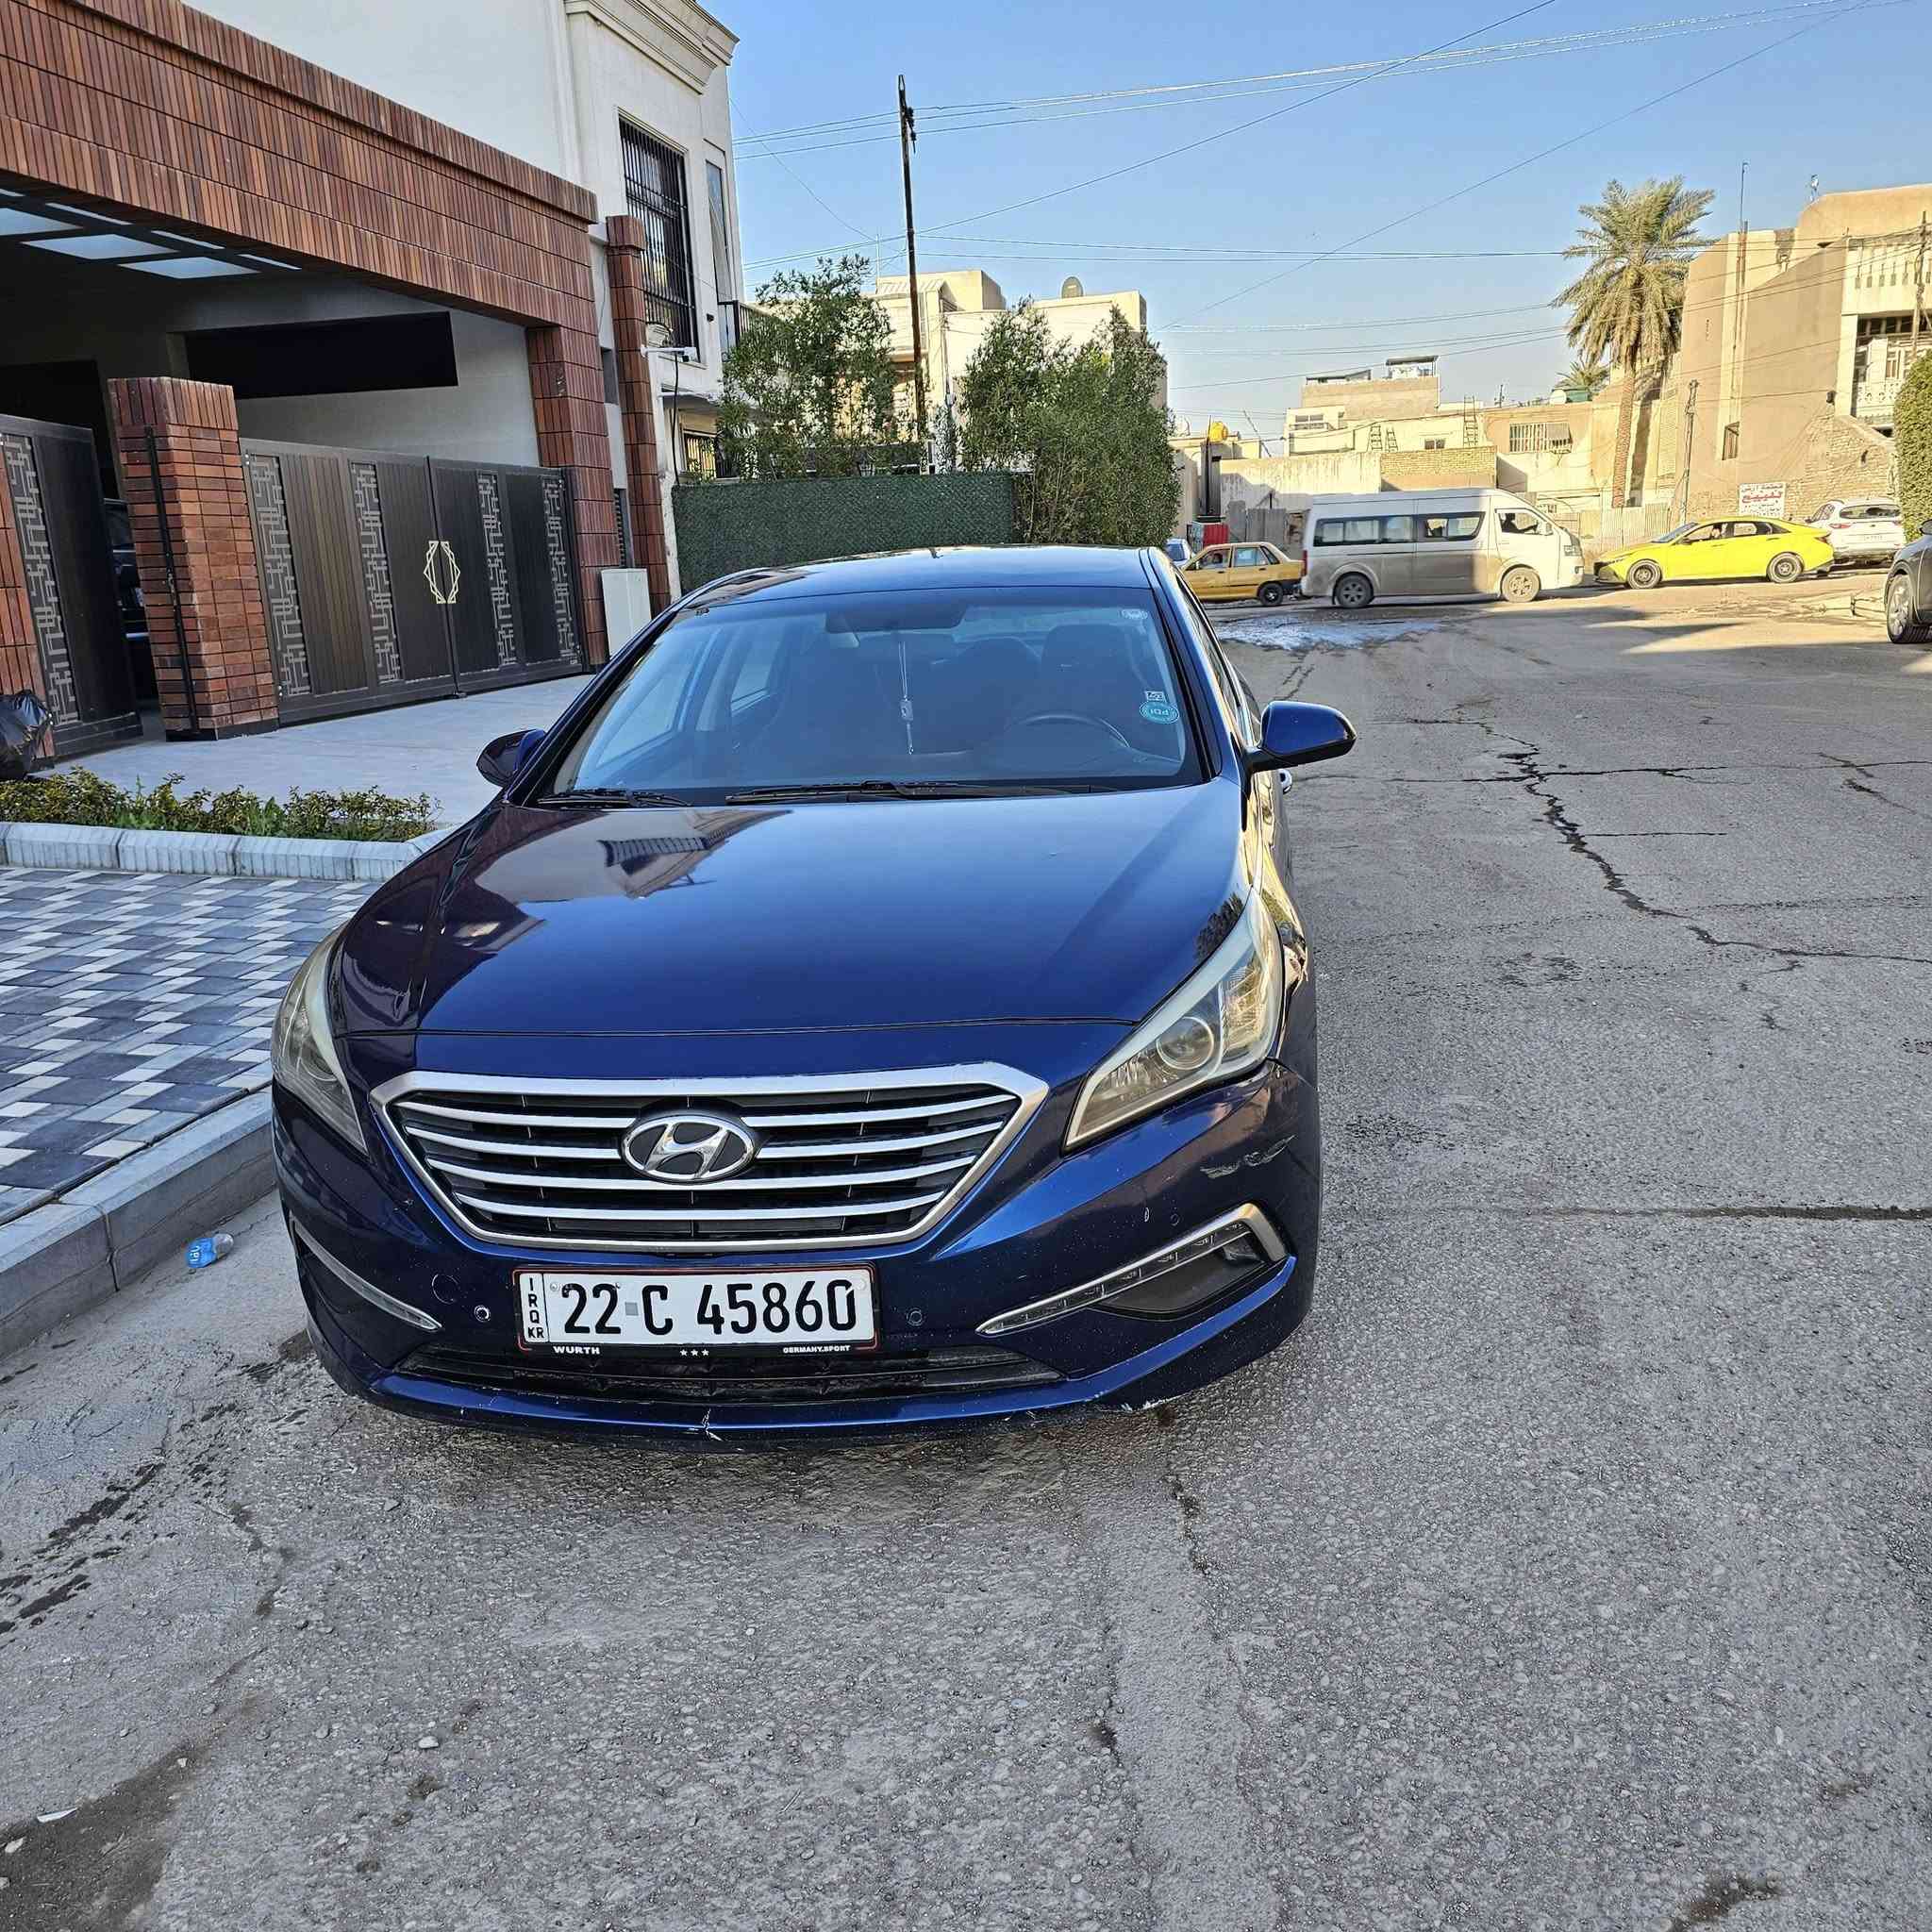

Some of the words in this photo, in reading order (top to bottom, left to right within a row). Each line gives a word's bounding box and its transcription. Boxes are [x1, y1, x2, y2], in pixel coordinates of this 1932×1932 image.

[561, 1283, 622, 1335] 22
[641, 1284, 674, 1336] C
[696, 1279, 857, 1335] 45860
[527, 1326, 544, 1339] KR
[552, 1345, 601, 1356] WURTH
